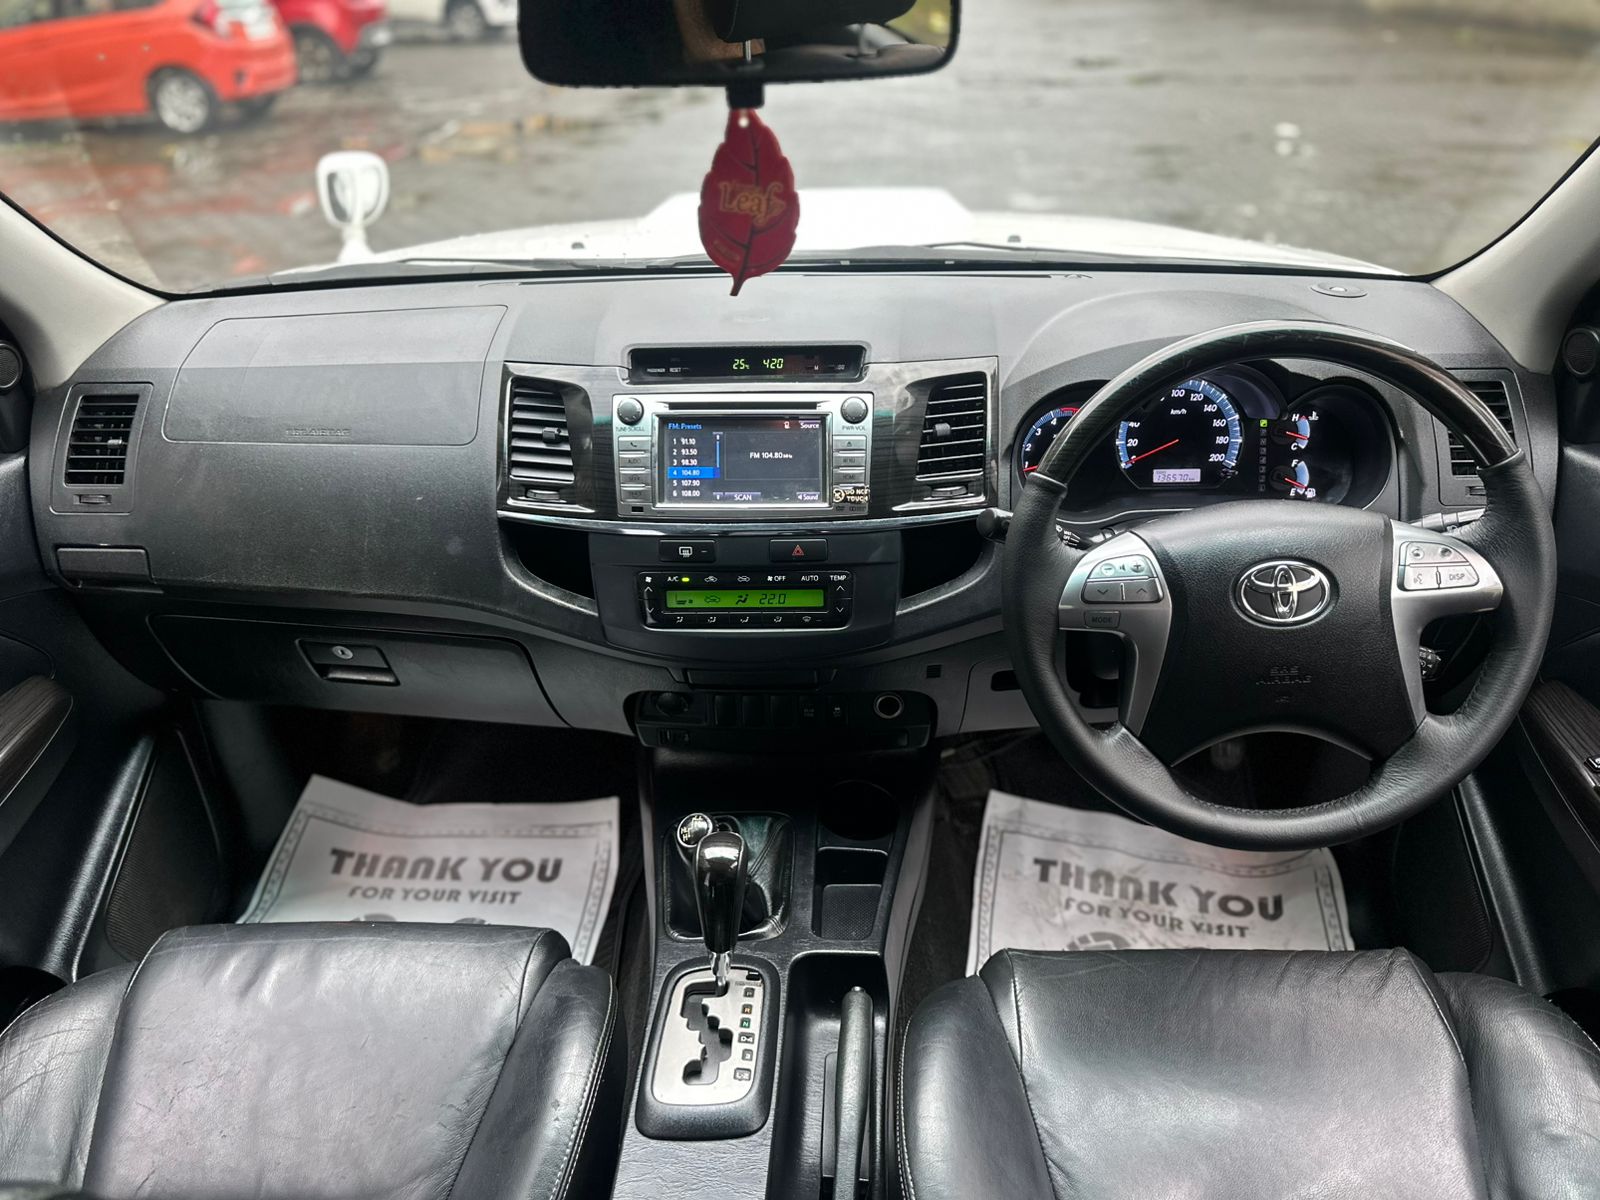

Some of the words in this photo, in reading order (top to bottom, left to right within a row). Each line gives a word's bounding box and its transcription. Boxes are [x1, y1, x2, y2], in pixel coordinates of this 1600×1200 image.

[719, 181, 786, 227] Leaf
[1171, 389, 1185, 397] 100
[1190, 393, 1204, 401] 120
[1204, 404, 1217, 412] 140
[1291, 413, 1300, 422] H
[1213, 419, 1226, 427] 160
[1035, 428, 1042, 436] 3
[1127, 438, 1138, 447] 20
[1216, 436, 1229, 444] 180
[1290, 442, 1298, 450] C
[1208, 453, 1225, 462] 200
[734, 493, 752, 501] SCAN
[803, 492, 819, 501] Sound
[1448, 573, 1466, 581] DISP
[330, 848, 467, 881] THANK
[479, 857, 562, 883] YOU
[1033, 858, 1178, 908] THANK
[1191, 885, 1284, 921] YOU
[348, 886, 396, 899] FOR
[402, 887, 461, 903] YOUR
[467, 889, 521, 904] VISIT
[1064, 897, 1111, 918] FOR
[1118, 906, 1184, 932] YOUR
[1191, 918, 1249, 938] VISIT
